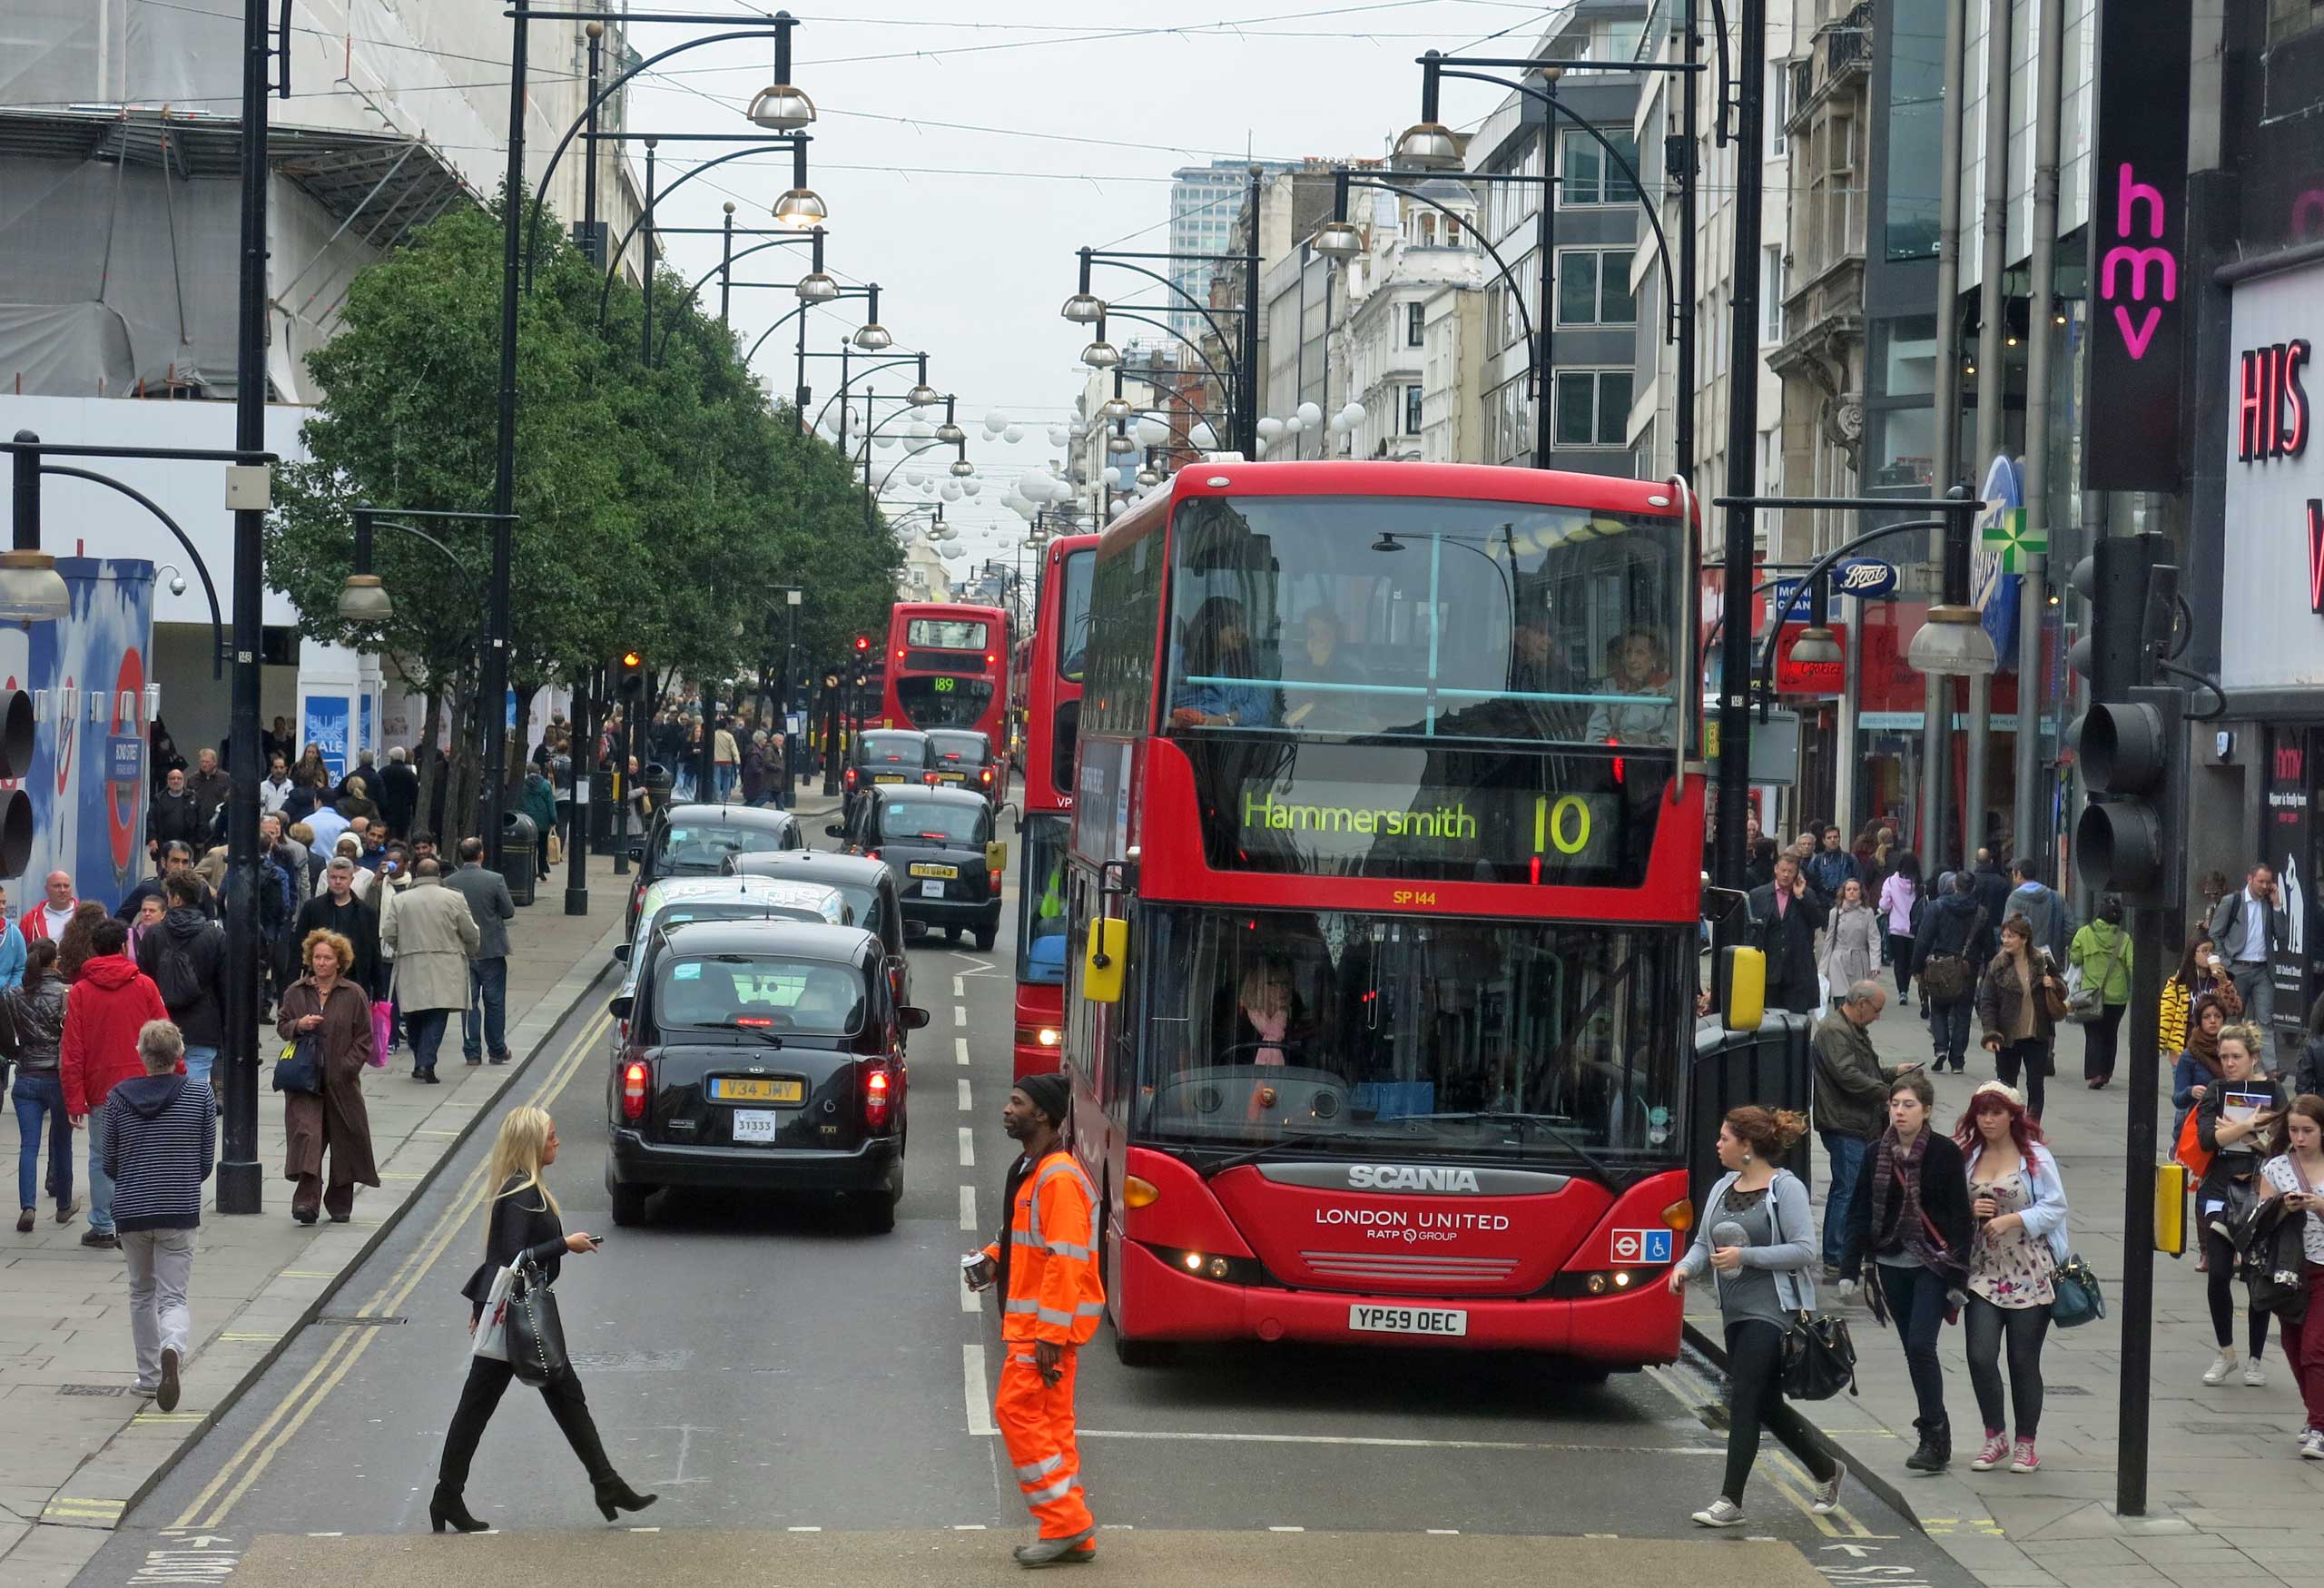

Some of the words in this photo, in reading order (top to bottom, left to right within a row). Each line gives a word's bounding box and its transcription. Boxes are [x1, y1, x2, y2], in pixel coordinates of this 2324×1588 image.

[2102, 163, 2176, 360] hmv
[2239, 339, 2311, 462] HIS
[1839, 564, 1888, 588] Boots
[935, 677, 954, 691] 189
[310, 715, 343, 729] BLUE
[310, 730, 343, 739] CROSS
[1245, 792, 1476, 839] Hammersmith
[1533, 794, 1591, 854] 10
[1393, 891, 1412, 903] SP
[1415, 892, 1436, 904] 144
[728, 1080, 758, 1096] V34
[738, 1119, 772, 1132] 31333
[1348, 1166, 1480, 1192] SCANIA
[1316, 1208, 1407, 1226] LONDON
[1418, 1212, 1510, 1230] UNITED
[1367, 1229, 1400, 1238] RATP
[1418, 1230, 1457, 1241] GROUP
[1358, 1308, 1412, 1329] YP59
[1417, 1311, 1458, 1332] OEC
